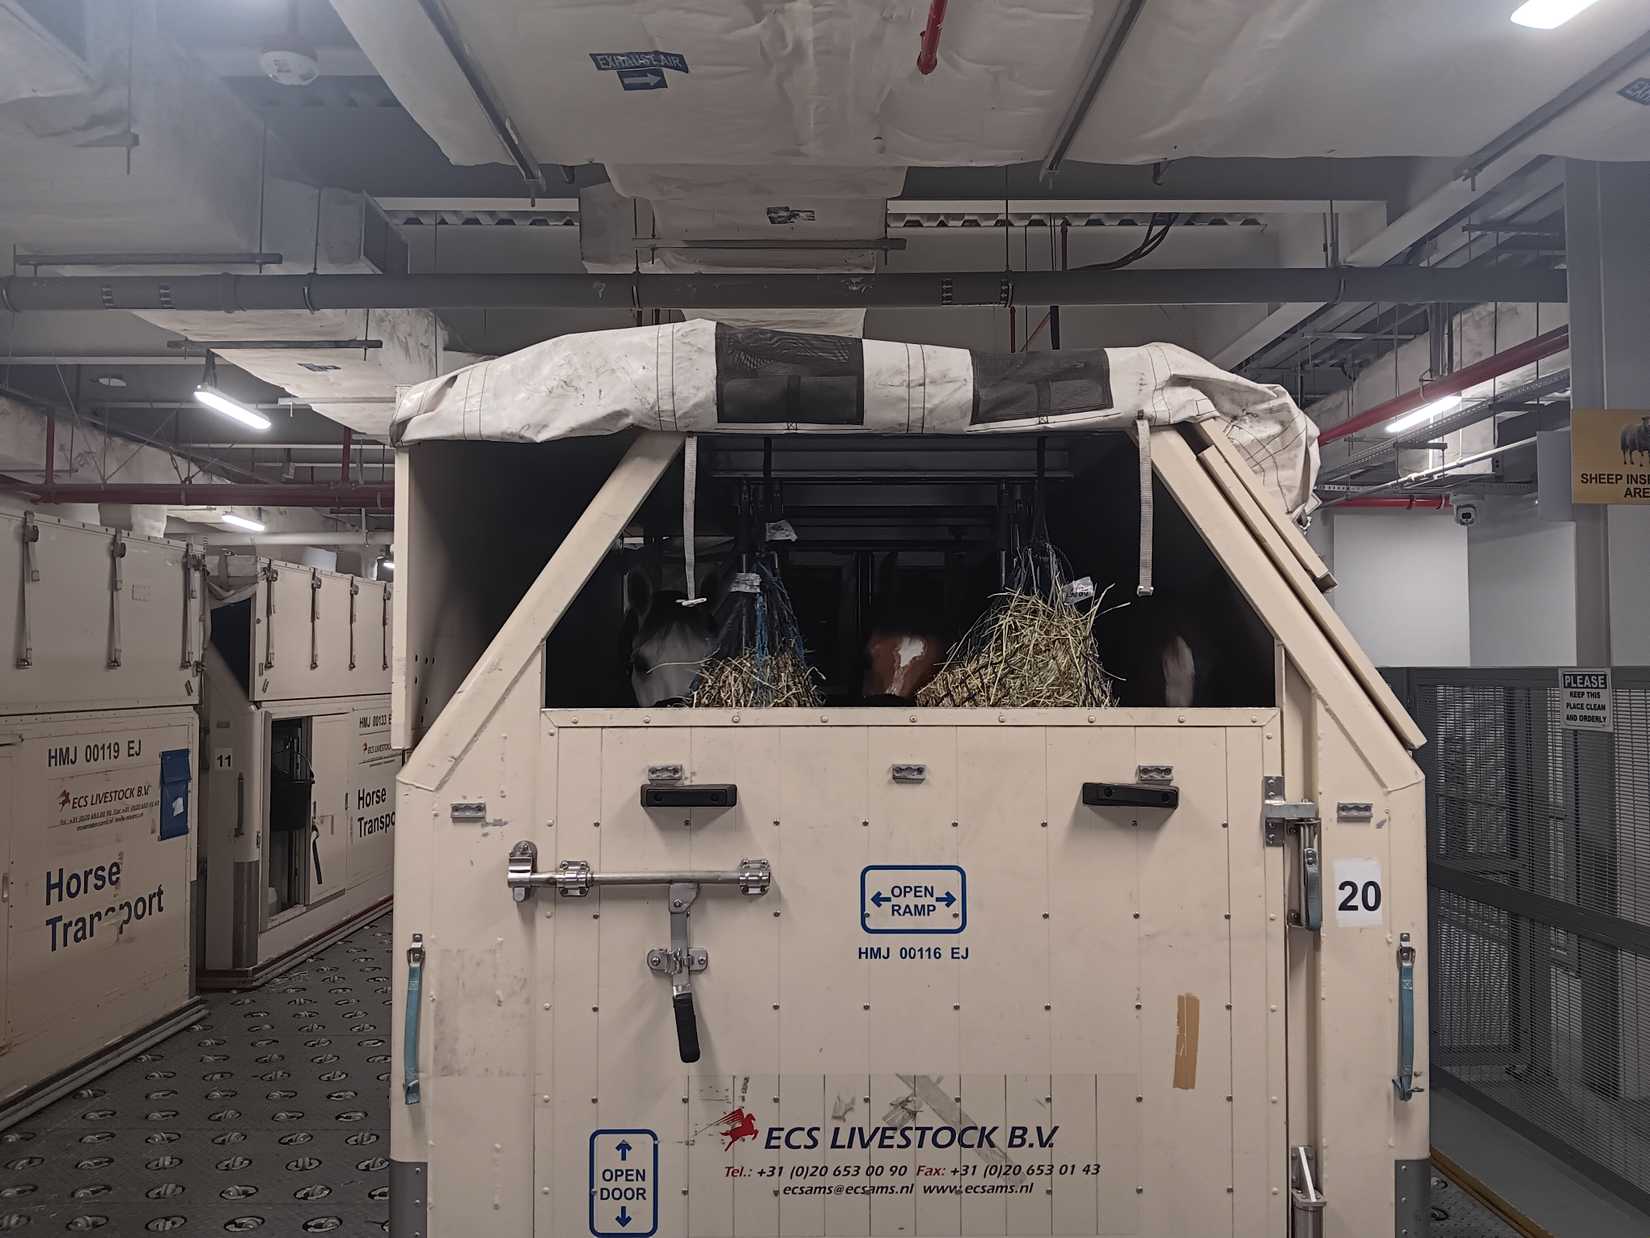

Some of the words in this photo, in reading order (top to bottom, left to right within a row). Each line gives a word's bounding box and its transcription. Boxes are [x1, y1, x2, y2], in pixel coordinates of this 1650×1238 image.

[661, 54, 682, 68] AIR
[1580, 473, 1623, 484] SHEEP
[1564, 675, 1606, 688] PLEASE
[1586, 691, 1600, 699] THIS
[1566, 702, 1584, 710] PLACE
[359, 715, 371, 728] HMJ
[1579, 714, 1607, 723] ORDERLY
[48, 745, 77, 767] HMJ
[85, 742, 120, 762] 00119
[127, 739, 142, 757] EJ
[216, 754, 231, 768] 11
[72, 796, 88, 809] ECS
[91, 786, 135, 806] LIVESTOCK
[137, 784, 150, 797] B.V.
[357, 787, 387, 810] Horse
[46, 861, 121, 906] Horse
[891, 885, 935, 898] OPEN
[1338, 880, 1382, 912] 20
[891, 904, 937, 917] RAMP
[858, 947, 890, 960] HMJ
[899, 947, 942, 960] 00116
[950, 947, 969, 960] EJ
[764, 1126, 821, 1150] ECS
[830, 1125, 999, 1150] LIVESTOCK
[1008, 1125, 1060, 1149] B.V.
[602, 1168, 646, 1182] OPEN
[724, 1165, 752, 1178] Tel.:
[757, 1165, 784, 1178] +31
[790, 1165, 828, 1181] (0)20
[832, 1165, 860, 1177] 653
[865, 1165, 884, 1177] 00
[889, 1165, 908, 1177] 90
[916, 1165, 946, 1178] Fax:
[950, 1164, 977, 1177] +31
[983, 1164, 1022, 1180] (0)20
[1026, 1164, 1054, 1177] 653
[1059, 1164, 1076, 1176] 01
[1082, 1163, 1101, 1176] 43
[600, 1187, 647, 1201] DOOR
[783, 1182, 914, 1196] ecsams@ecsams.nl
[923, 1182, 1034, 1195] www.ecsams.nl
